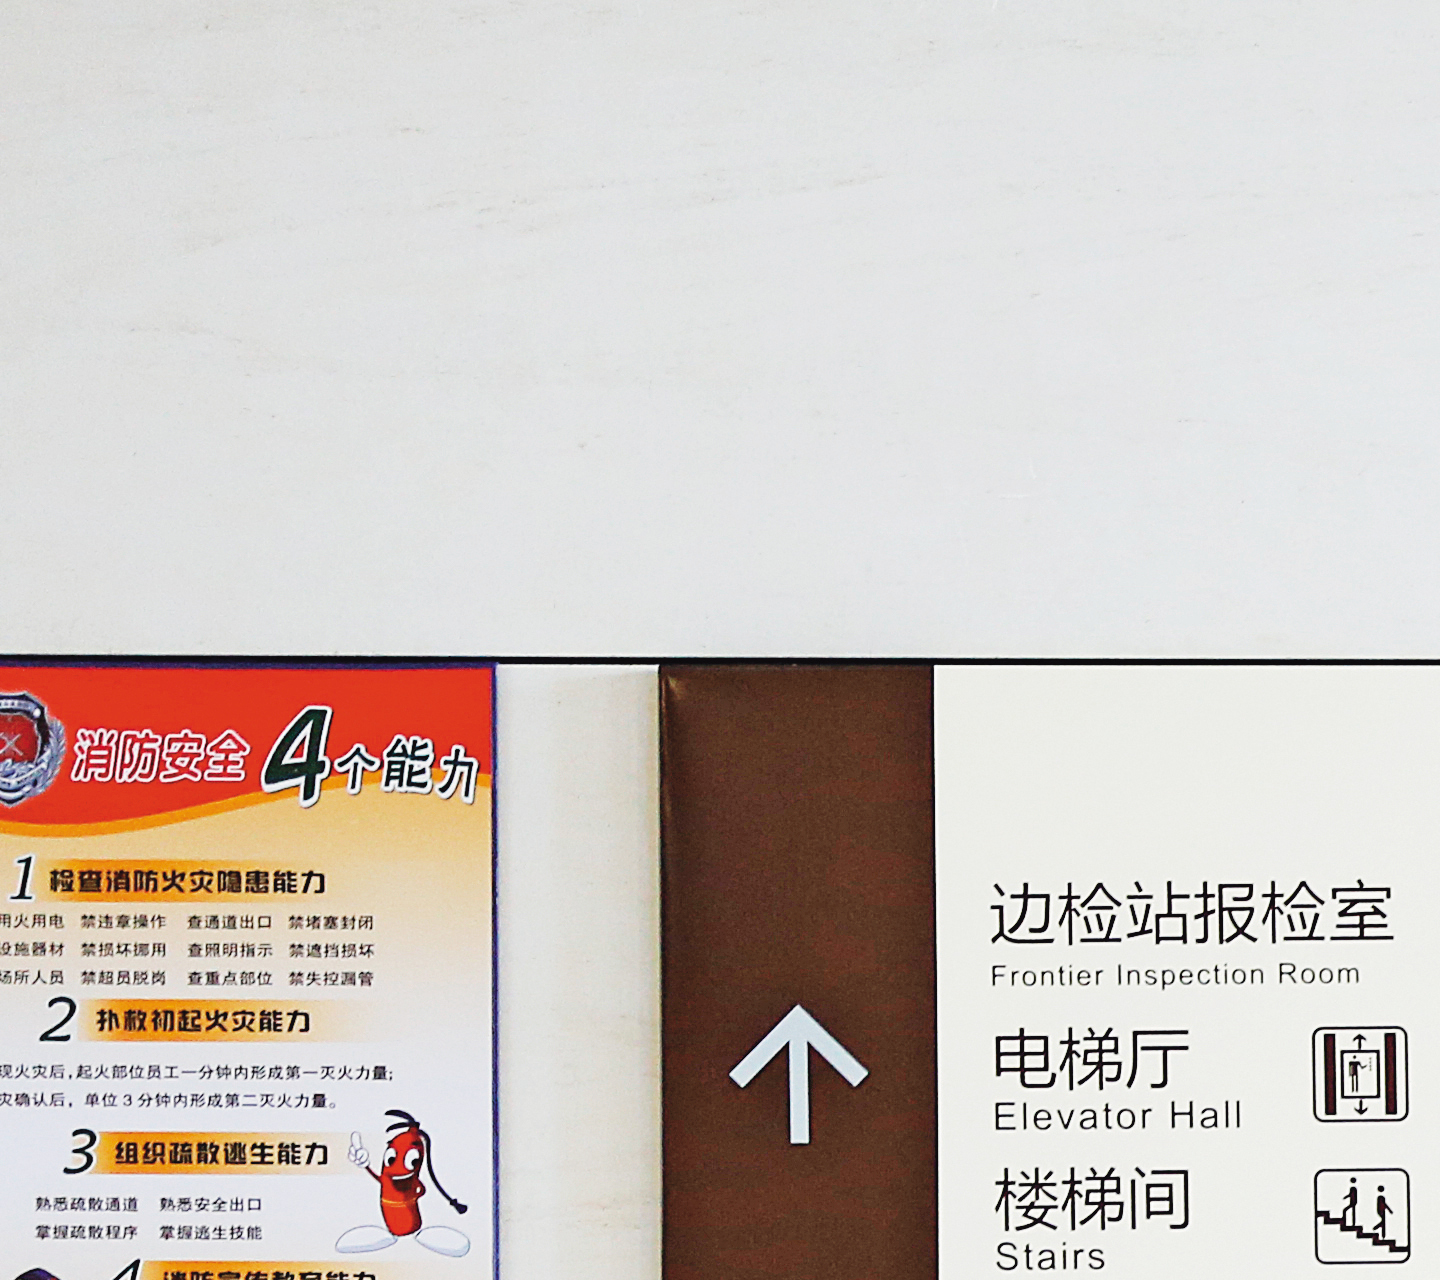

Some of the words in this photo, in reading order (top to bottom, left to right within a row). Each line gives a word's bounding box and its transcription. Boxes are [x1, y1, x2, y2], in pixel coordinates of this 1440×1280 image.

[9, 856, 35, 900] 1
[81, 914, 166, 930] 禁违章操作
[187, 914, 272, 930] 查通道出口
[990, 879, 1394, 946] 边检站报检室
[187, 942, 273, 958] 查照明指示
[81, 970, 166, 986] 禁超员脱岗
[187, 970, 273, 986] 查重点部位
[992, 965, 1104, 986] Frontier
[1118, 963, 1263, 991] Inspection
[1279, 963, 1359, 984] Room
[39, 996, 77, 1042] 2
[97, 1009, 311, 1033] 扑救初起火灾能力
[995, 1027, 1189, 1091] 电梯厅
[995, 1102, 1152, 1130] Elevator
[1171, 1100, 1240, 1129] Hall
[63, 1128, 97, 1175] 3
[115, 1141, 328, 1166] 组织疏散逃生能力
[36, 1197, 139, 1213] 熟悉疏散通道
[160, 1197, 262, 1213] 熟悉安全出口
[995, 1166, 1189, 1231] 楼梯间
[36, 1225, 139, 1241] 掌握疏散程序
[160, 1225, 263, 1241] 掌握逃生技能
[996, 1242, 1105, 1271] Stairs
